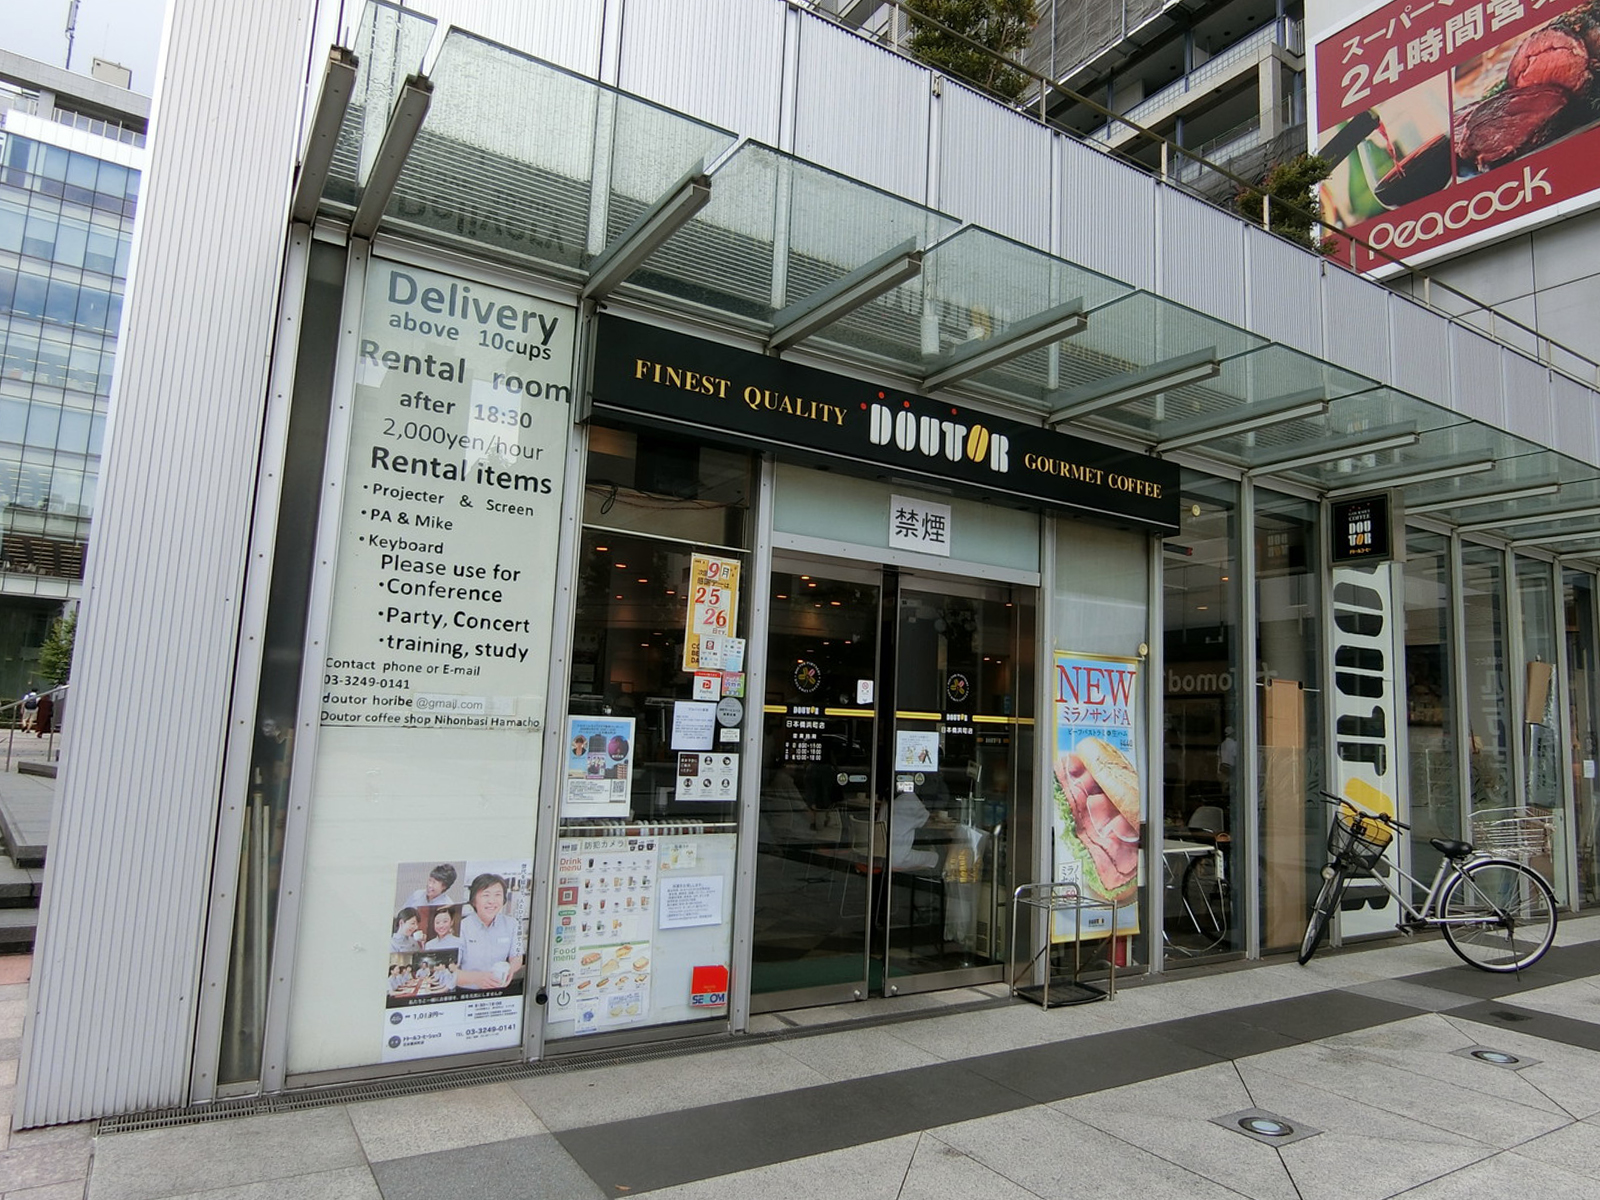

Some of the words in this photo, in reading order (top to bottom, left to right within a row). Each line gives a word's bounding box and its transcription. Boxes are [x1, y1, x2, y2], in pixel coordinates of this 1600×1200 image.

[1341, 0, 1454, 64] スーパー
[1369, 165, 1552, 261] peacock
[388, 270, 558, 346] Delivery
[389, 312, 459, 340] above
[478, 329, 551, 361] 10cups
[359, 339, 466, 383] Rental
[492, 371, 571, 403] room
[400, 391, 456, 414] after
[473, 404, 532, 428] 18:30
[382, 417, 543, 461] 2,000yen/hour
[634, 358, 731, 399] FINEST
[743, 386, 847, 426] QUALITY
[869, 402, 1009, 473] DOUTOR
[1024, 453, 1104, 486] GOURMET
[1108, 472, 1163, 499] COFFEE
[371, 446, 466, 481] Rental
[476, 461, 551, 494] items
[372, 483, 445, 504] Projecter
[459, 494, 473, 509] &
[486, 499, 534, 517] Screen
[370, 508, 392, 523] PA
[397, 512, 409, 526] &
[415, 514, 453, 530] Mike
[895, 507, 946, 544] 禁煙
[1349, 520, 1371, 534] DOU
[369, 534, 444, 554] Keyboard
[381, 554, 446, 575] Please
[453, 565, 486, 579] use
[493, 564, 521, 582] for
[387, 578, 503, 603] Conference
[453, 611, 530, 633] Concert
[475, 642, 529, 663] study
[325, 657, 375, 671] Contact
[383, 661, 422, 674] phone
[426, 664, 439, 674] or
[442, 664, 480, 676] E-mail
[323, 675, 410, 689] 03-3249-0141
[1055, 665, 1137, 707] NEW
[322, 692, 367, 706] doutor
[372, 694, 413, 707] horibe
[320, 711, 361, 723] Doutor
[365, 713, 401, 724] coffee
[404, 714, 431, 725] shop
[434, 714, 489, 726] Nihonbasi
[491, 717, 540, 728] Hamacho
[1063, 706, 1131, 726] ミラノサンドA
[584, 840, 624, 850] 防犯カメラ
[560, 858, 581, 866] Drink
[560, 864, 581, 872] menu
[553, 947, 576, 956] Food
